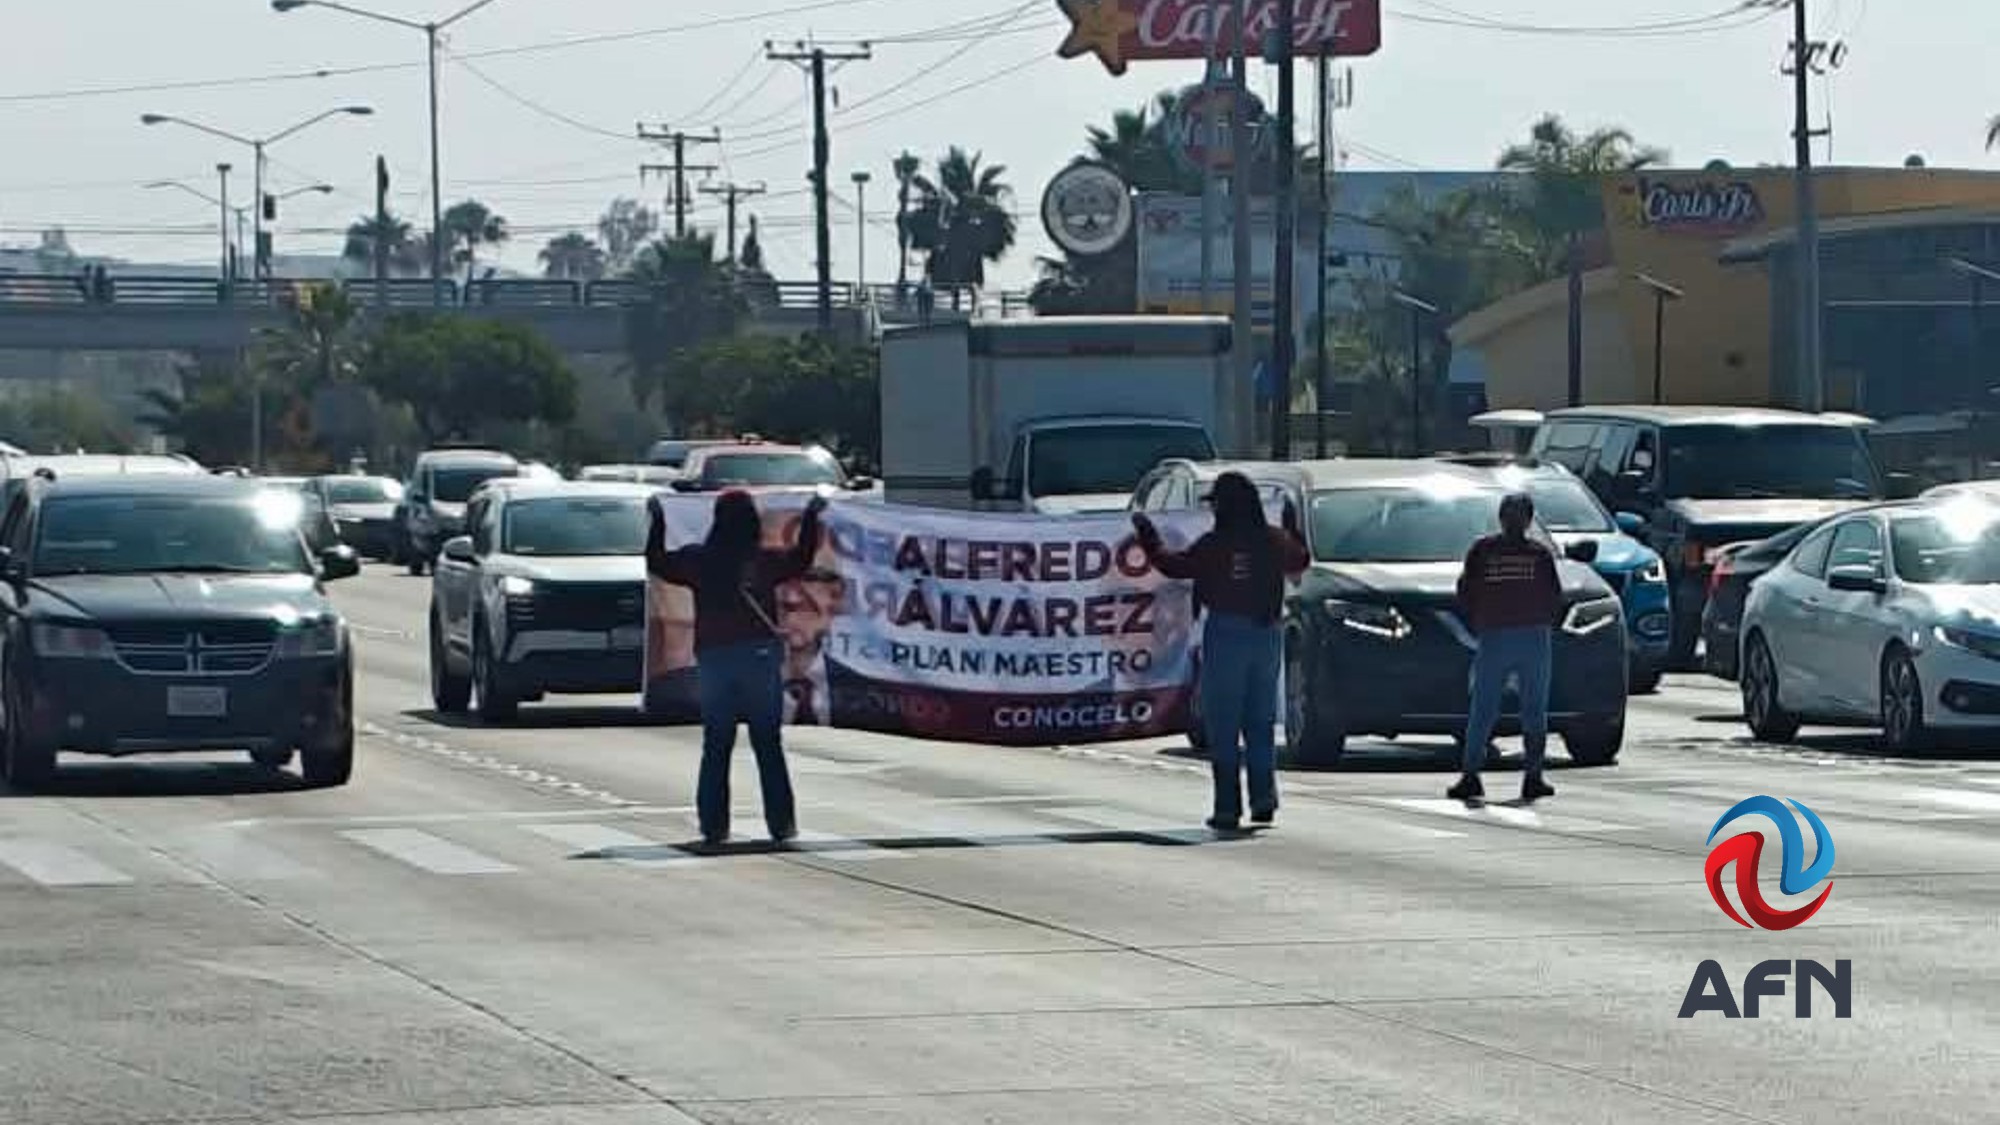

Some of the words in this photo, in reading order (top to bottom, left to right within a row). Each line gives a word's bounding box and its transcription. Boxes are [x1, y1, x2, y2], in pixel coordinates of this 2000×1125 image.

[895, 535, 1153, 582] ALFREDO
[896, 578, 1156, 637] ÁLVAREZ
[994, 650, 1151, 677] MAESTRO
